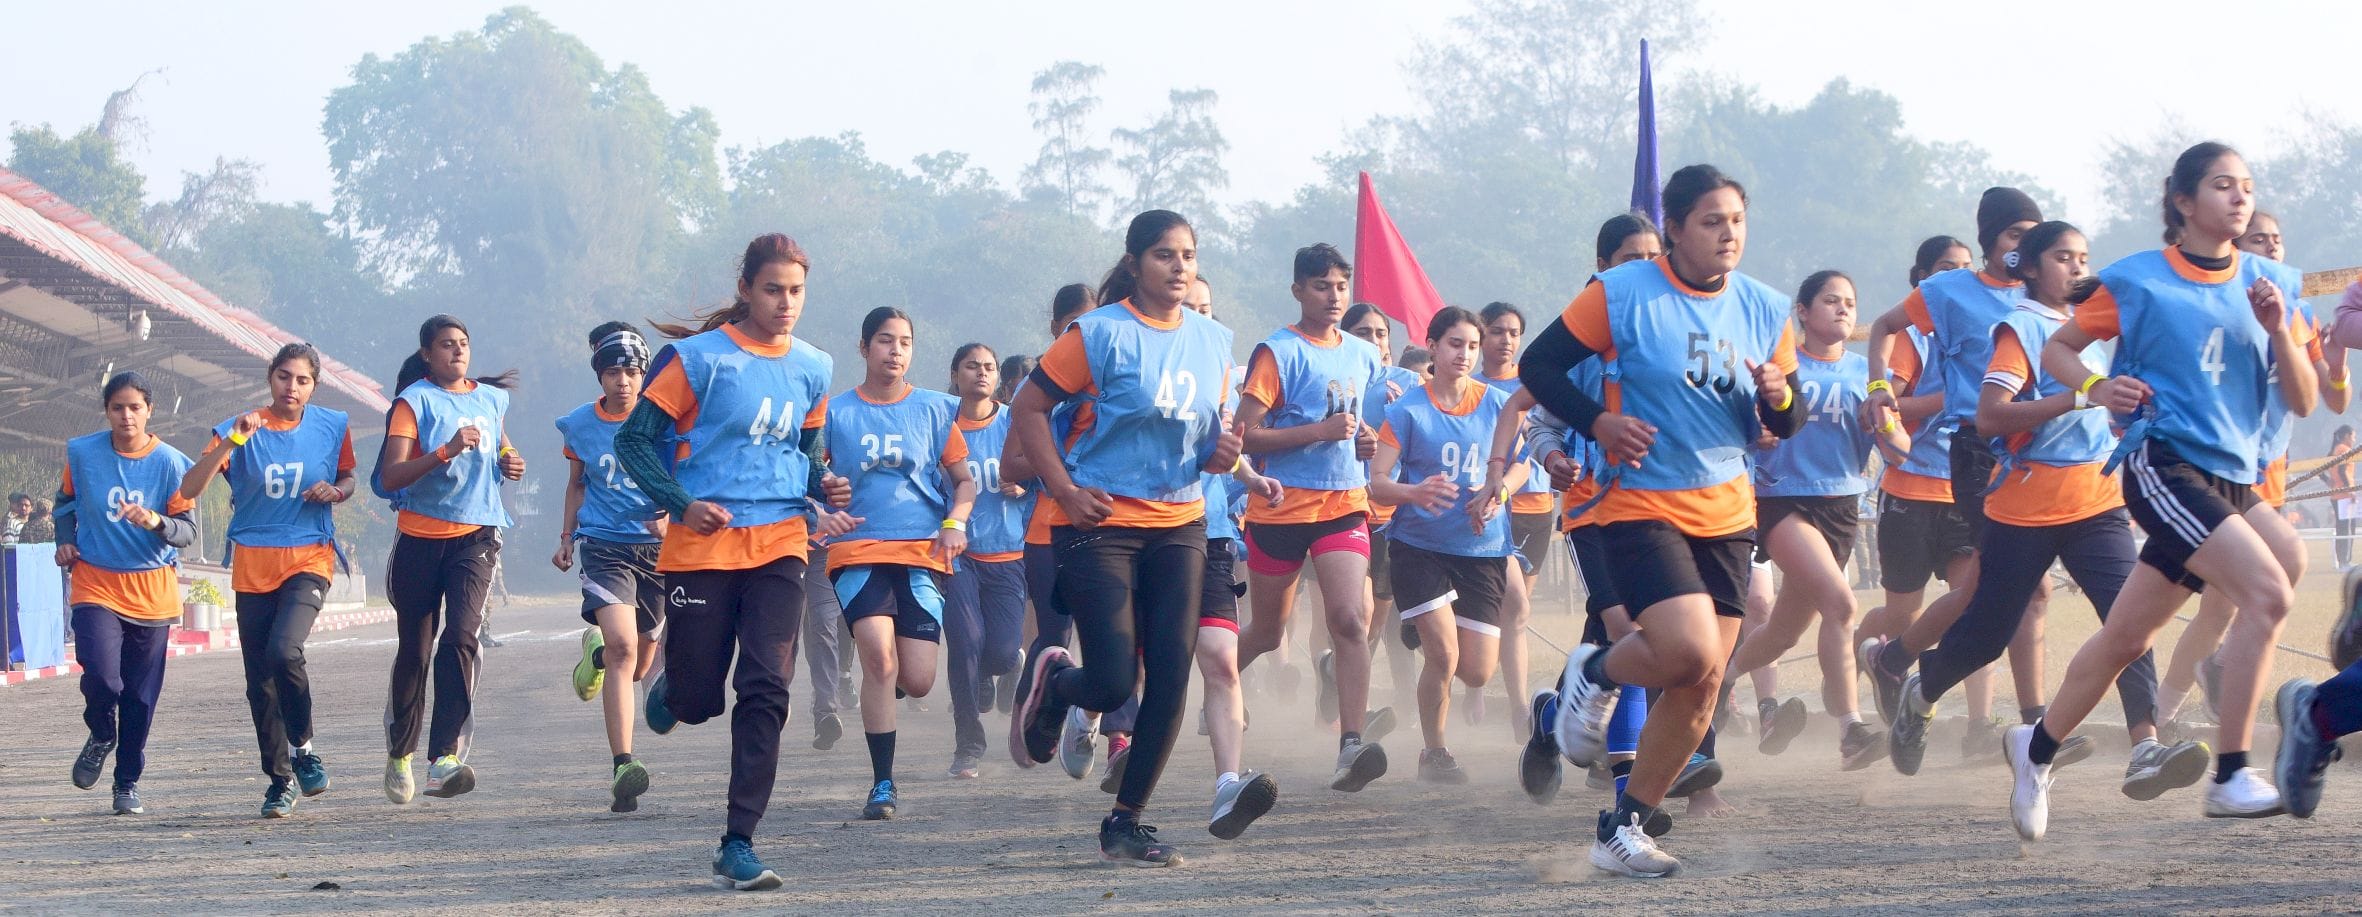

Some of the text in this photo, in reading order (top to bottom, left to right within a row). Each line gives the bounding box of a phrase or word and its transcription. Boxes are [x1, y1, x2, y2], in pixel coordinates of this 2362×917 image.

[1685, 332, 1737, 394] 53
[2200, 327, 2226, 385] 4
[1154, 368, 1198, 420] 42
[1801, 380, 1844, 423] 24
[750, 397, 794, 445] 44
[860, 433, 903, 471] 35
[1441, 441, 1480, 482] 94
[265, 462, 303, 499] 67
